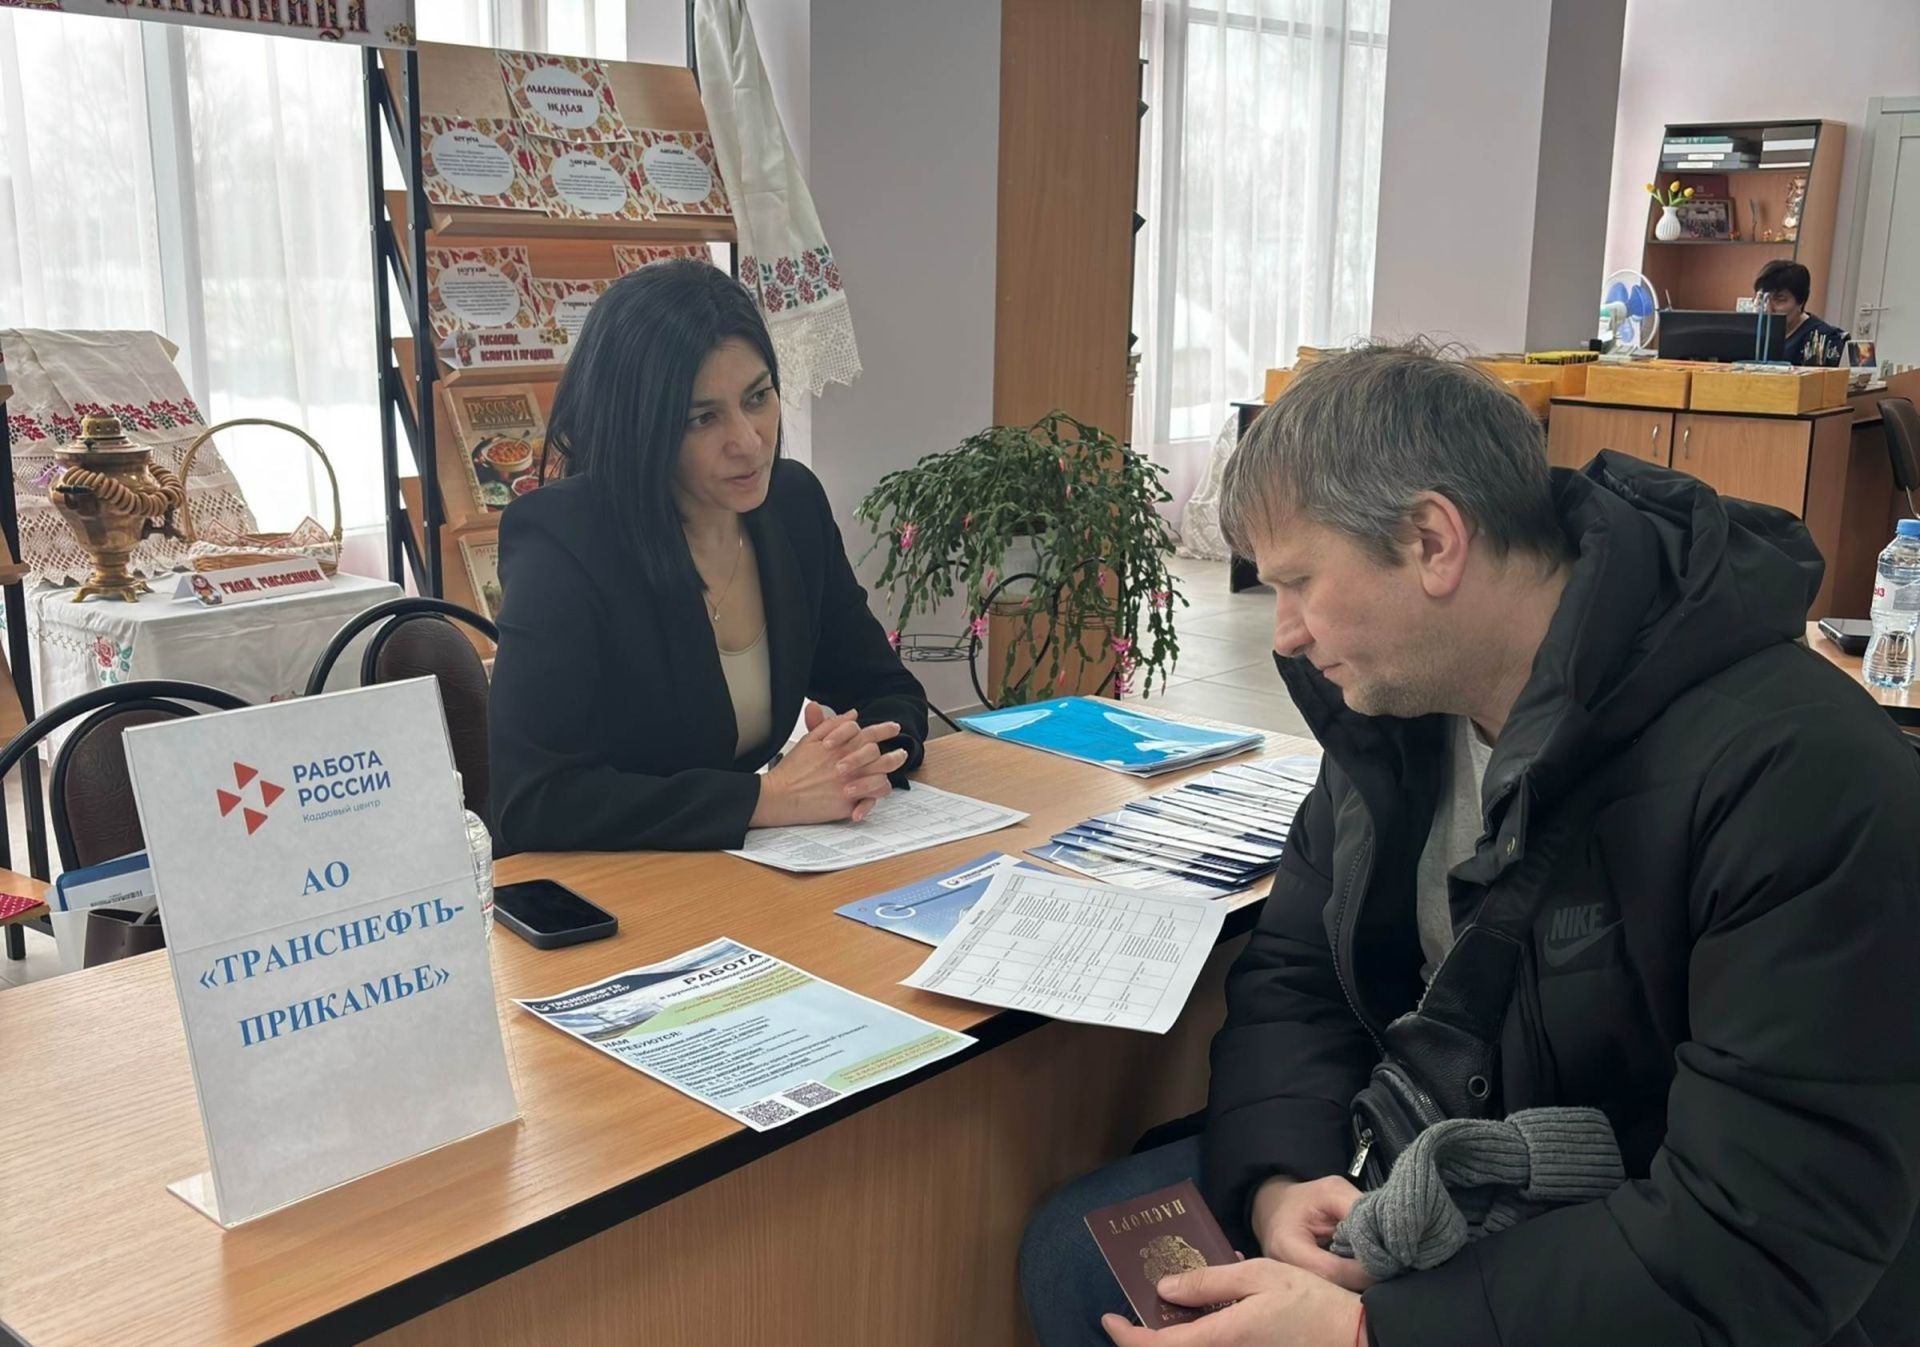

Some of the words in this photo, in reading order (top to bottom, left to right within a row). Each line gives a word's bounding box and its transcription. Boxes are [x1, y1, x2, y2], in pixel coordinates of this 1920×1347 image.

[526, 84, 595, 98] МАСЛЕНИЧНАЯ
[547, 102, 584, 116] НЕДЕЛЯ
[465, 400, 531, 424] РУССКАЯ
[293, 750, 382, 783] РАБОТА
[298, 770, 391, 807] РОССИИ
[303, 803, 351, 823] Кадровый
[353, 798, 381, 813] центр
[302, 861, 350, 896] АО
[1550, 903, 1603, 940] NIKE
[199, 898, 465, 989] «ТРАНСНЕФТЬ-
[683, 953, 763, 985] РАБОТА
[238, 964, 450, 1047] ПРИКАМЬЕ»
[1109, 1199, 1186, 1235] ПАСПОРТ
